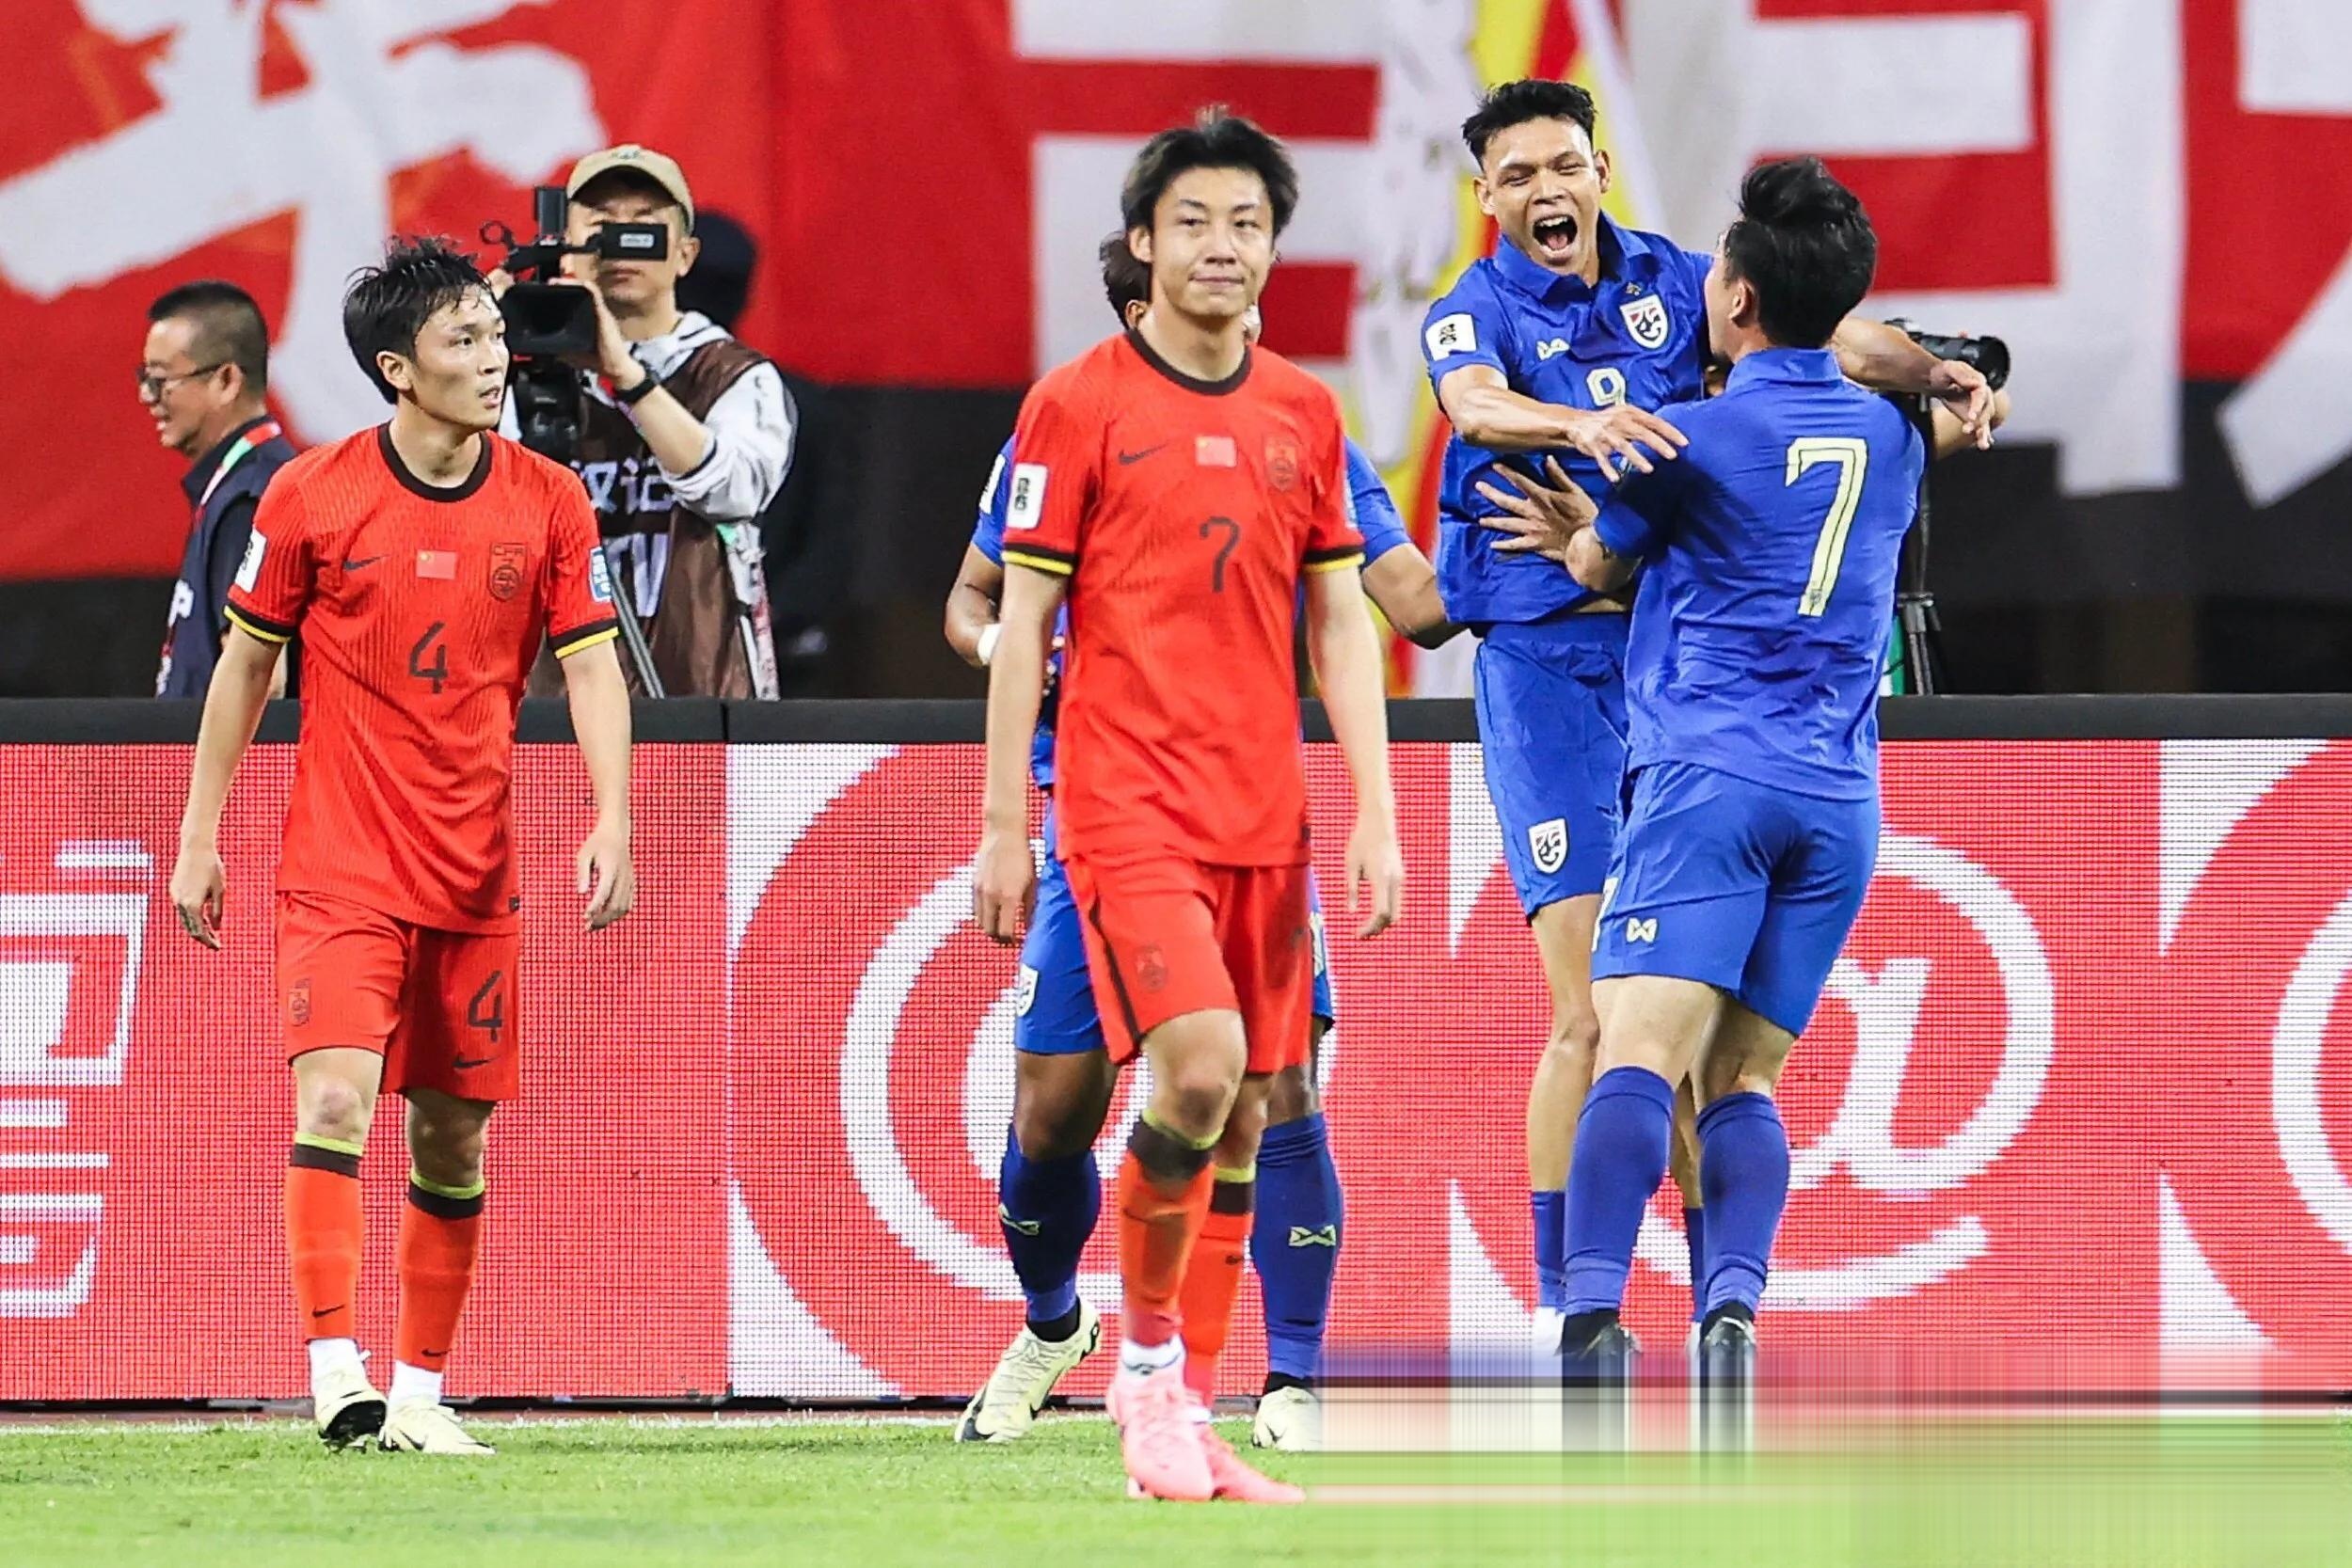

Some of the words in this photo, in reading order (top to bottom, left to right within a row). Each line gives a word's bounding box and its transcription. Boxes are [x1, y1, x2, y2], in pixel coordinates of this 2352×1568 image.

[1586, 367, 1627, 406] 9
[1200, 515, 1240, 594] 7
[1785, 436, 1867, 617] 7
[409, 621, 448, 694] 4
[467, 970, 503, 1043] 4
